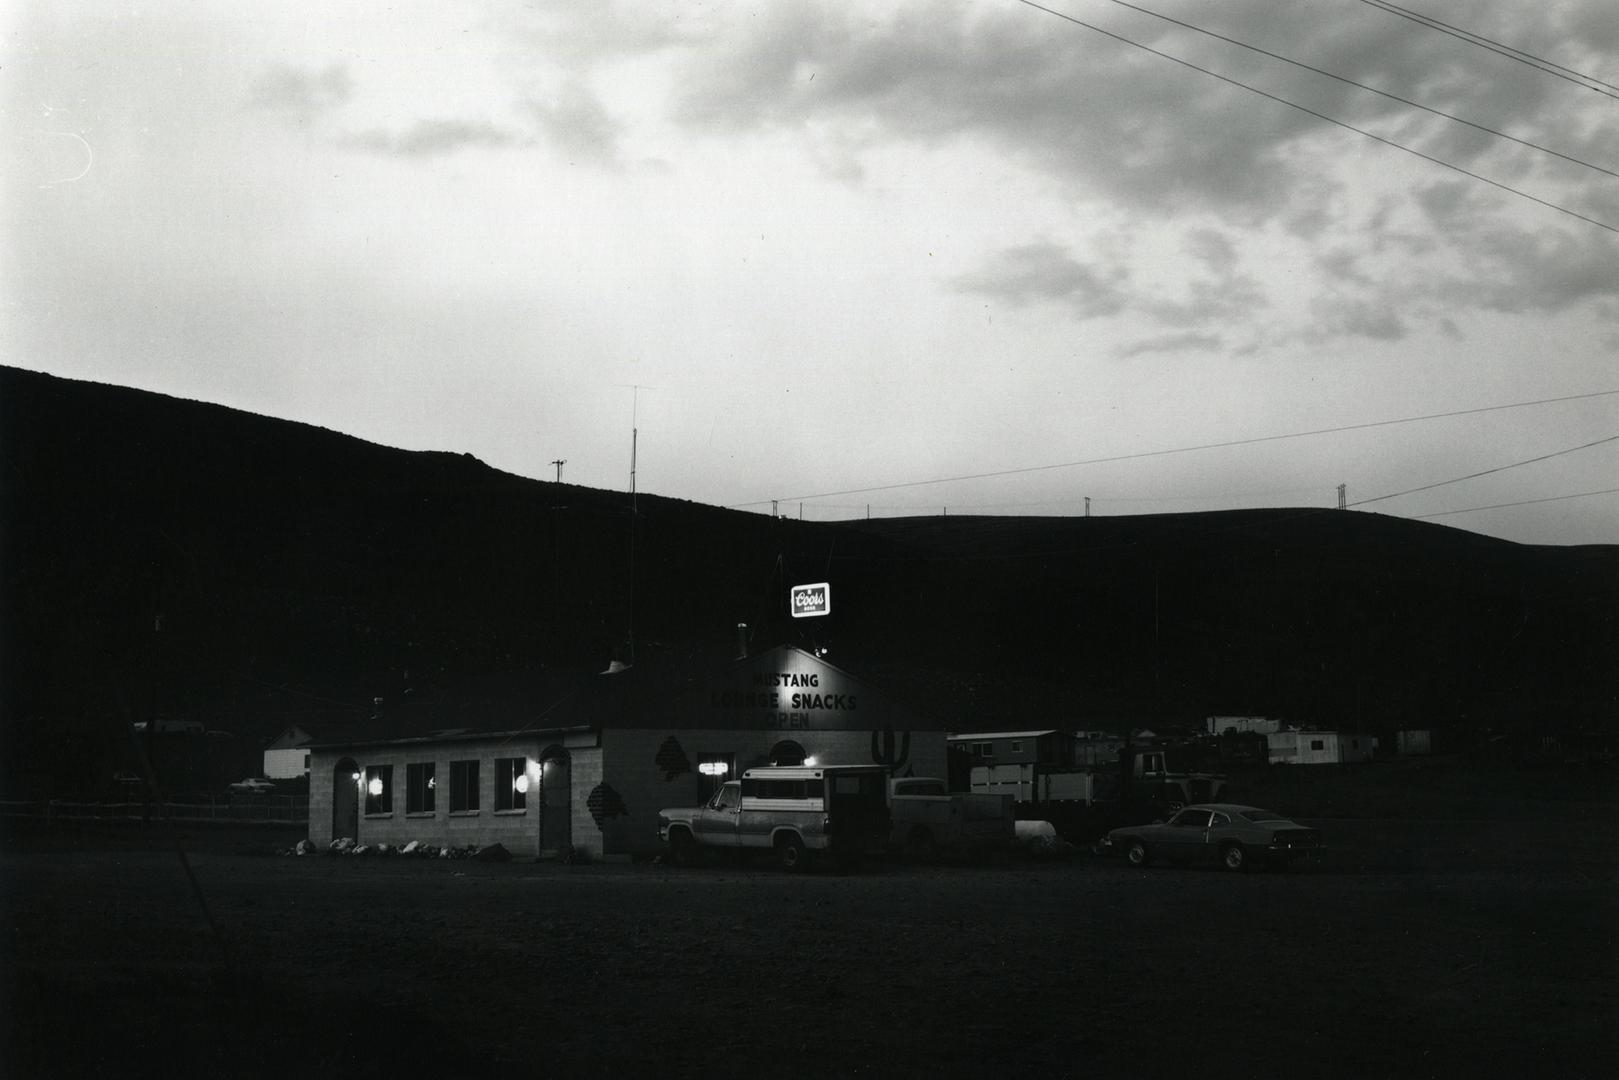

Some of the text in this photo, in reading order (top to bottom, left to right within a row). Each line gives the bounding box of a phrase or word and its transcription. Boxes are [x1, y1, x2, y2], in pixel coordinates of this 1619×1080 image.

[795, 592, 824, 607] Coors
[754, 673, 819, 687] MUSTANG
[711, 693, 857, 710] LOUNGE SNACKS
[765, 712, 809, 728] OPEN
